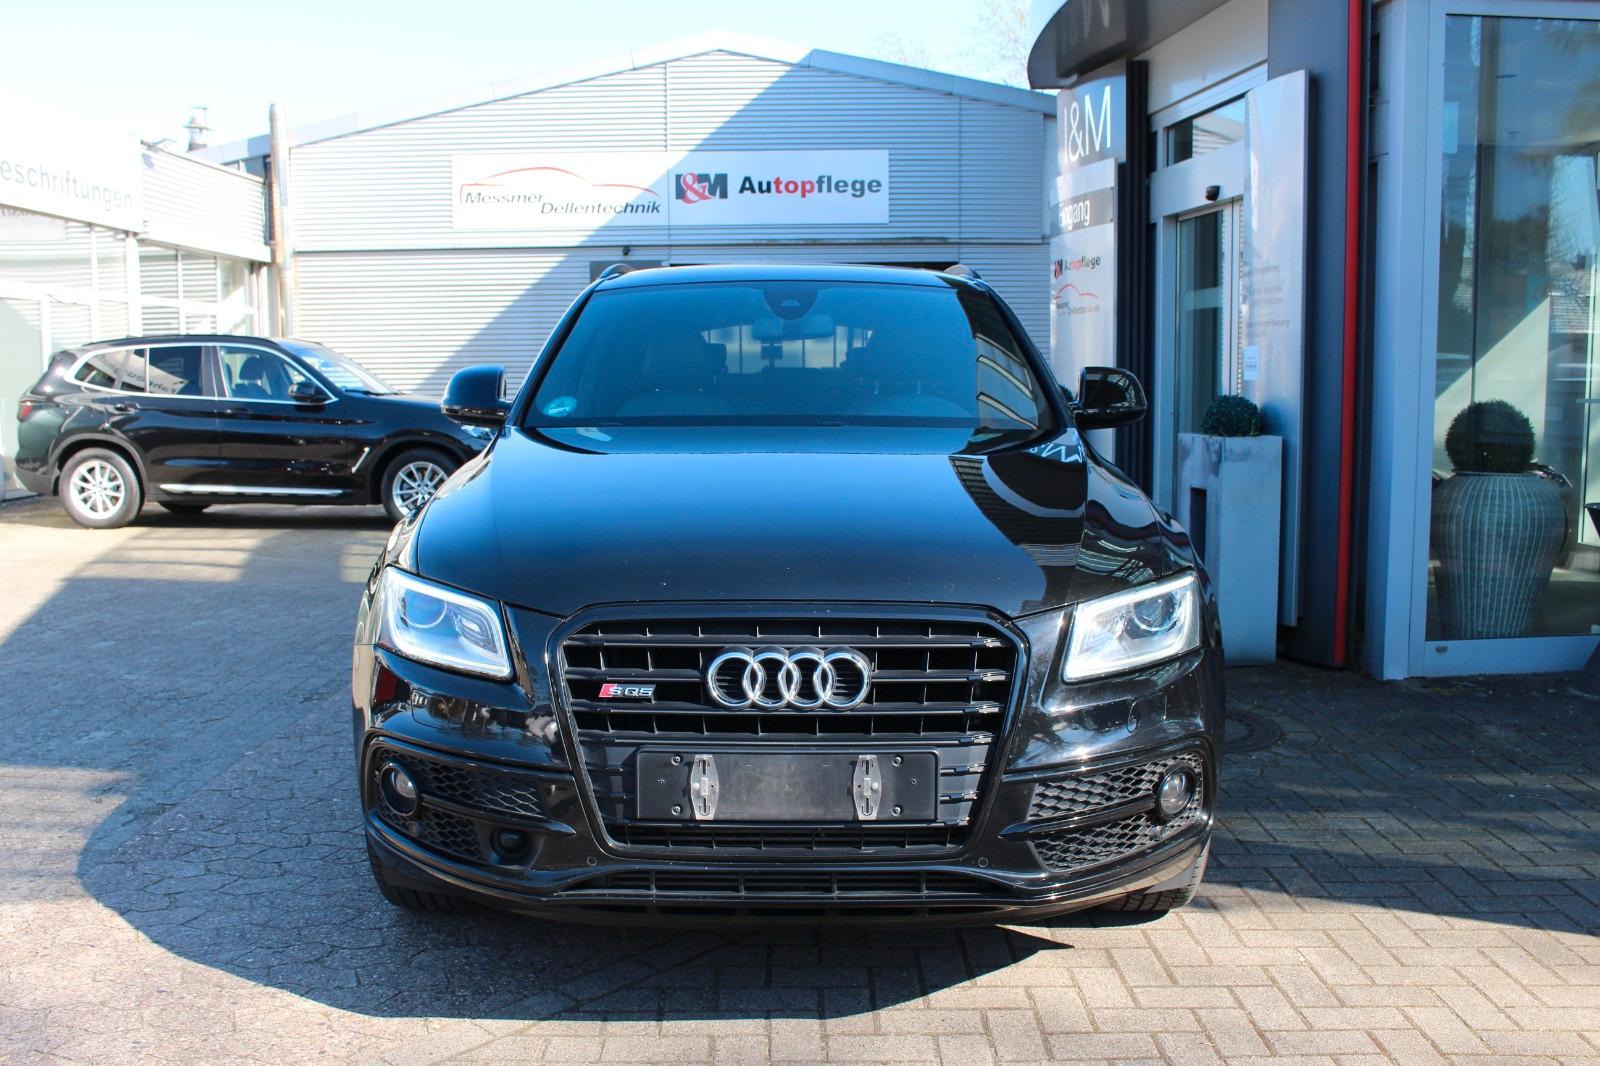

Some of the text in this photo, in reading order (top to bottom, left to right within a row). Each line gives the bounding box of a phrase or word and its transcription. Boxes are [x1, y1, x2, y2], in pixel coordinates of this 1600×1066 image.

[1063, 85, 1111, 164] I&M
[0, 160, 133, 212] eschriftungen
[739, 175, 882, 198] Autopflege
[465, 192, 543, 204] Messmer
[541, 201, 661, 214] Dellentechnik
[608, 687, 653, 697] SQ5
